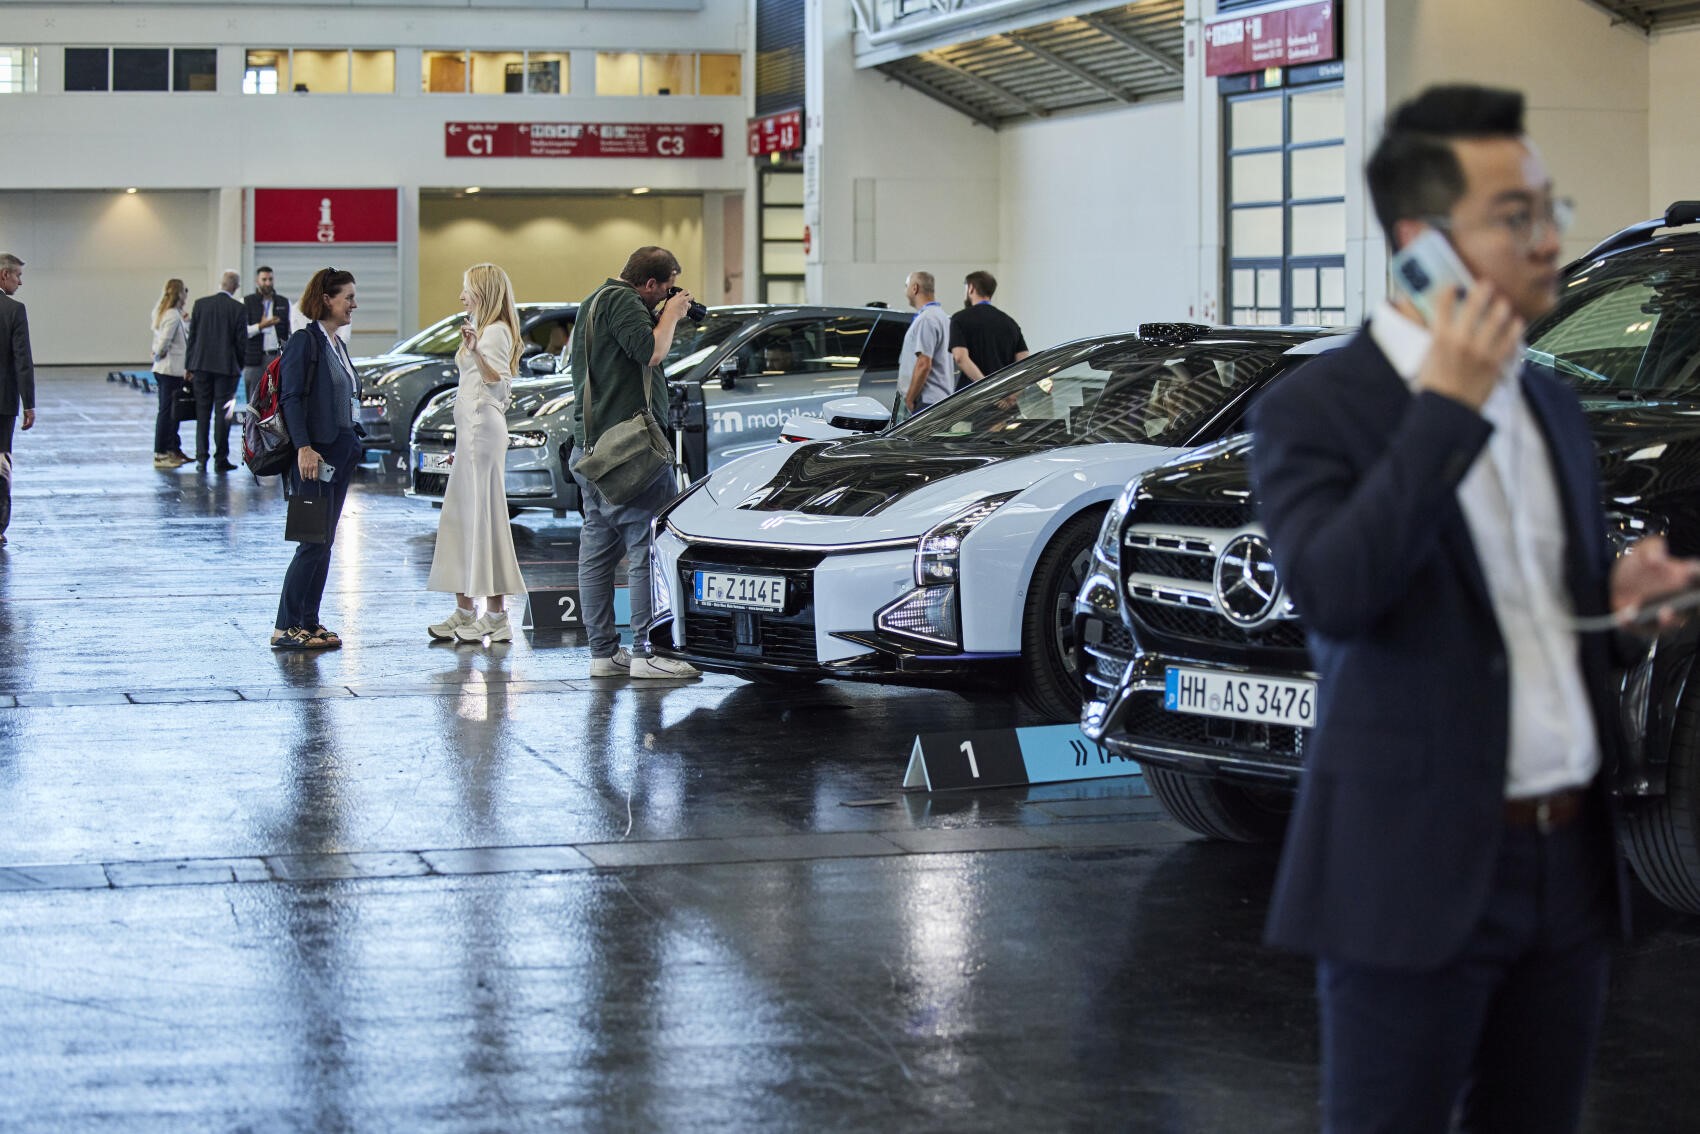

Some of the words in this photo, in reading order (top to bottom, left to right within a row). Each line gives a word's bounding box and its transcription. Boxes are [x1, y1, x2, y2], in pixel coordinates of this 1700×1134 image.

[467, 134, 493, 155] C1
[657, 136, 685, 155] C3
[317, 230, 335, 242] C2
[396, 456, 408, 471] 4
[707, 576, 717, 597] F
[558, 596, 578, 622] 2
[1180, 675, 1206, 708] HH
[1223, 680, 1250, 712] AS
[1256, 683, 1311, 720] 3476
[959, 740, 980, 778] 1
